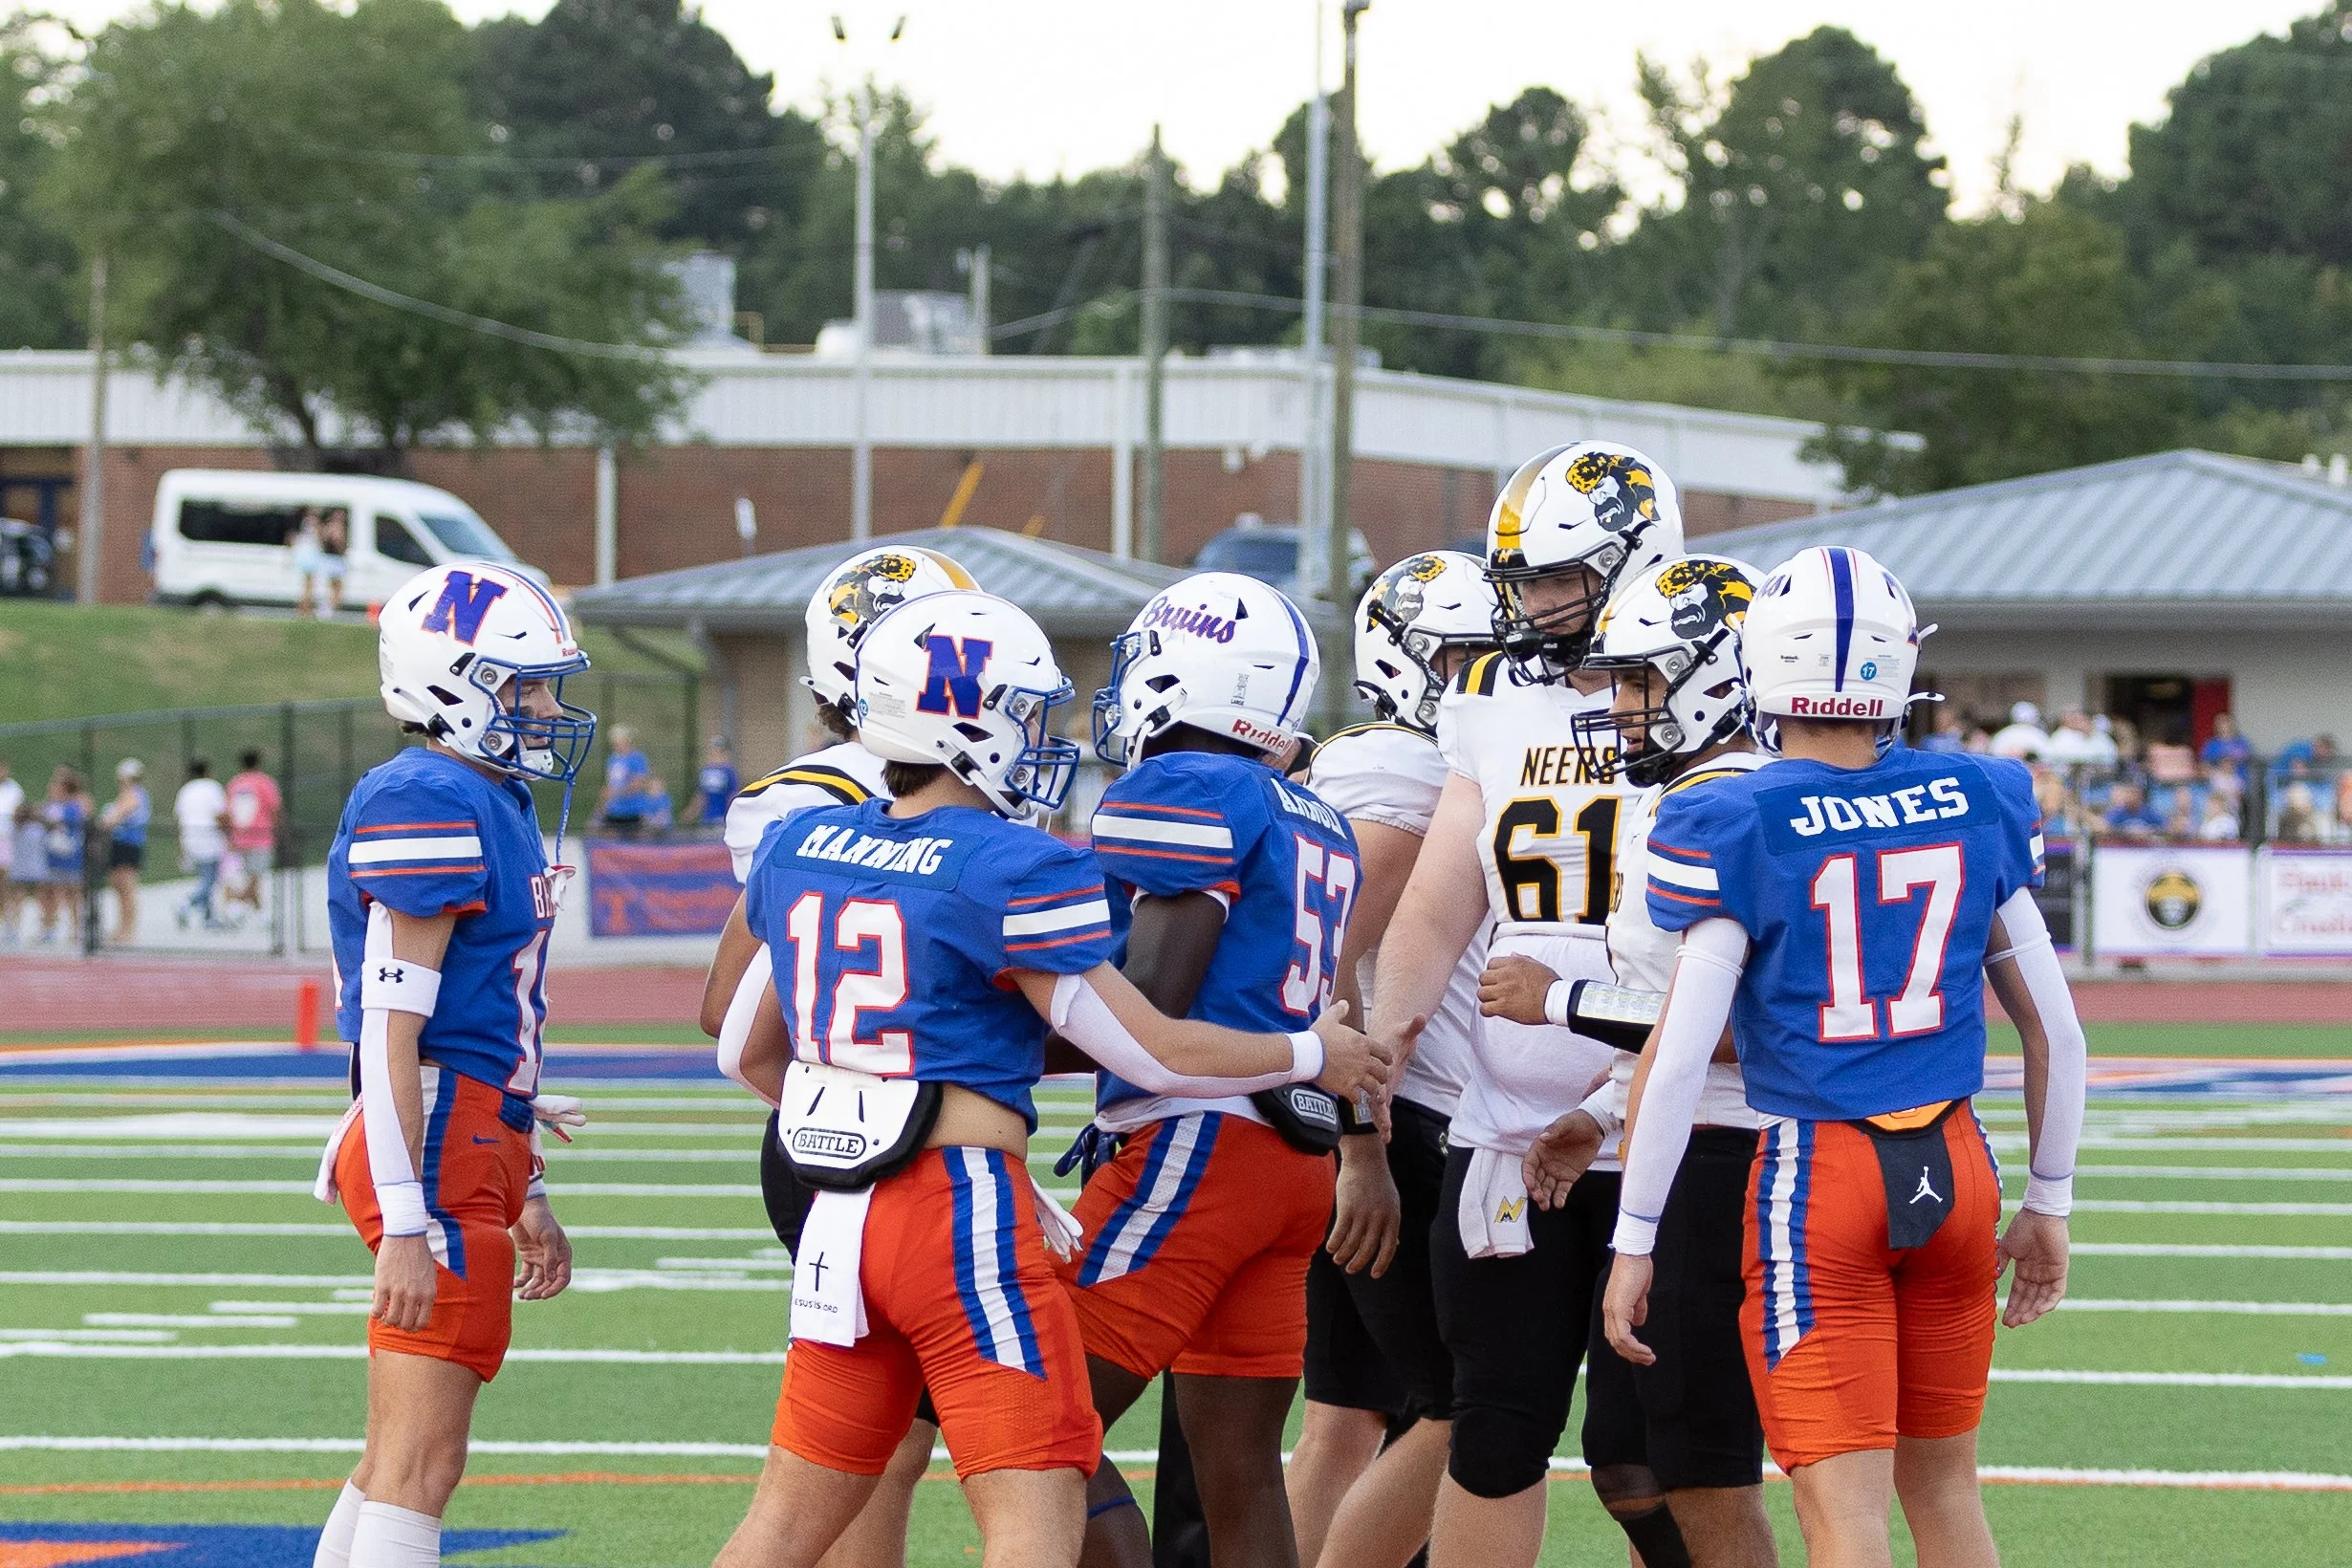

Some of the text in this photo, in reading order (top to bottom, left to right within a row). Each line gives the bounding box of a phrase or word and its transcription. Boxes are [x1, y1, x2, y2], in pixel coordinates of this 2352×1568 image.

[421, 571, 509, 645] N
[1143, 596, 1237, 644] Bruins
[916, 635, 993, 720] N
[1791, 697, 1884, 717] Riddell
[1518, 745, 1620, 788] NEERS
[1790, 776, 1970, 837] JONES
[795, 824, 953, 876] MANNING
[1492, 795, 1623, 924] 61
[1278, 831, 1357, 1016] 53
[1809, 841, 1965, 1043] 17
[787, 890, 915, 1077] 12
[1296, 1094, 1335, 1118] BATTLE
[797, 1133, 860, 1154] BATTLE
